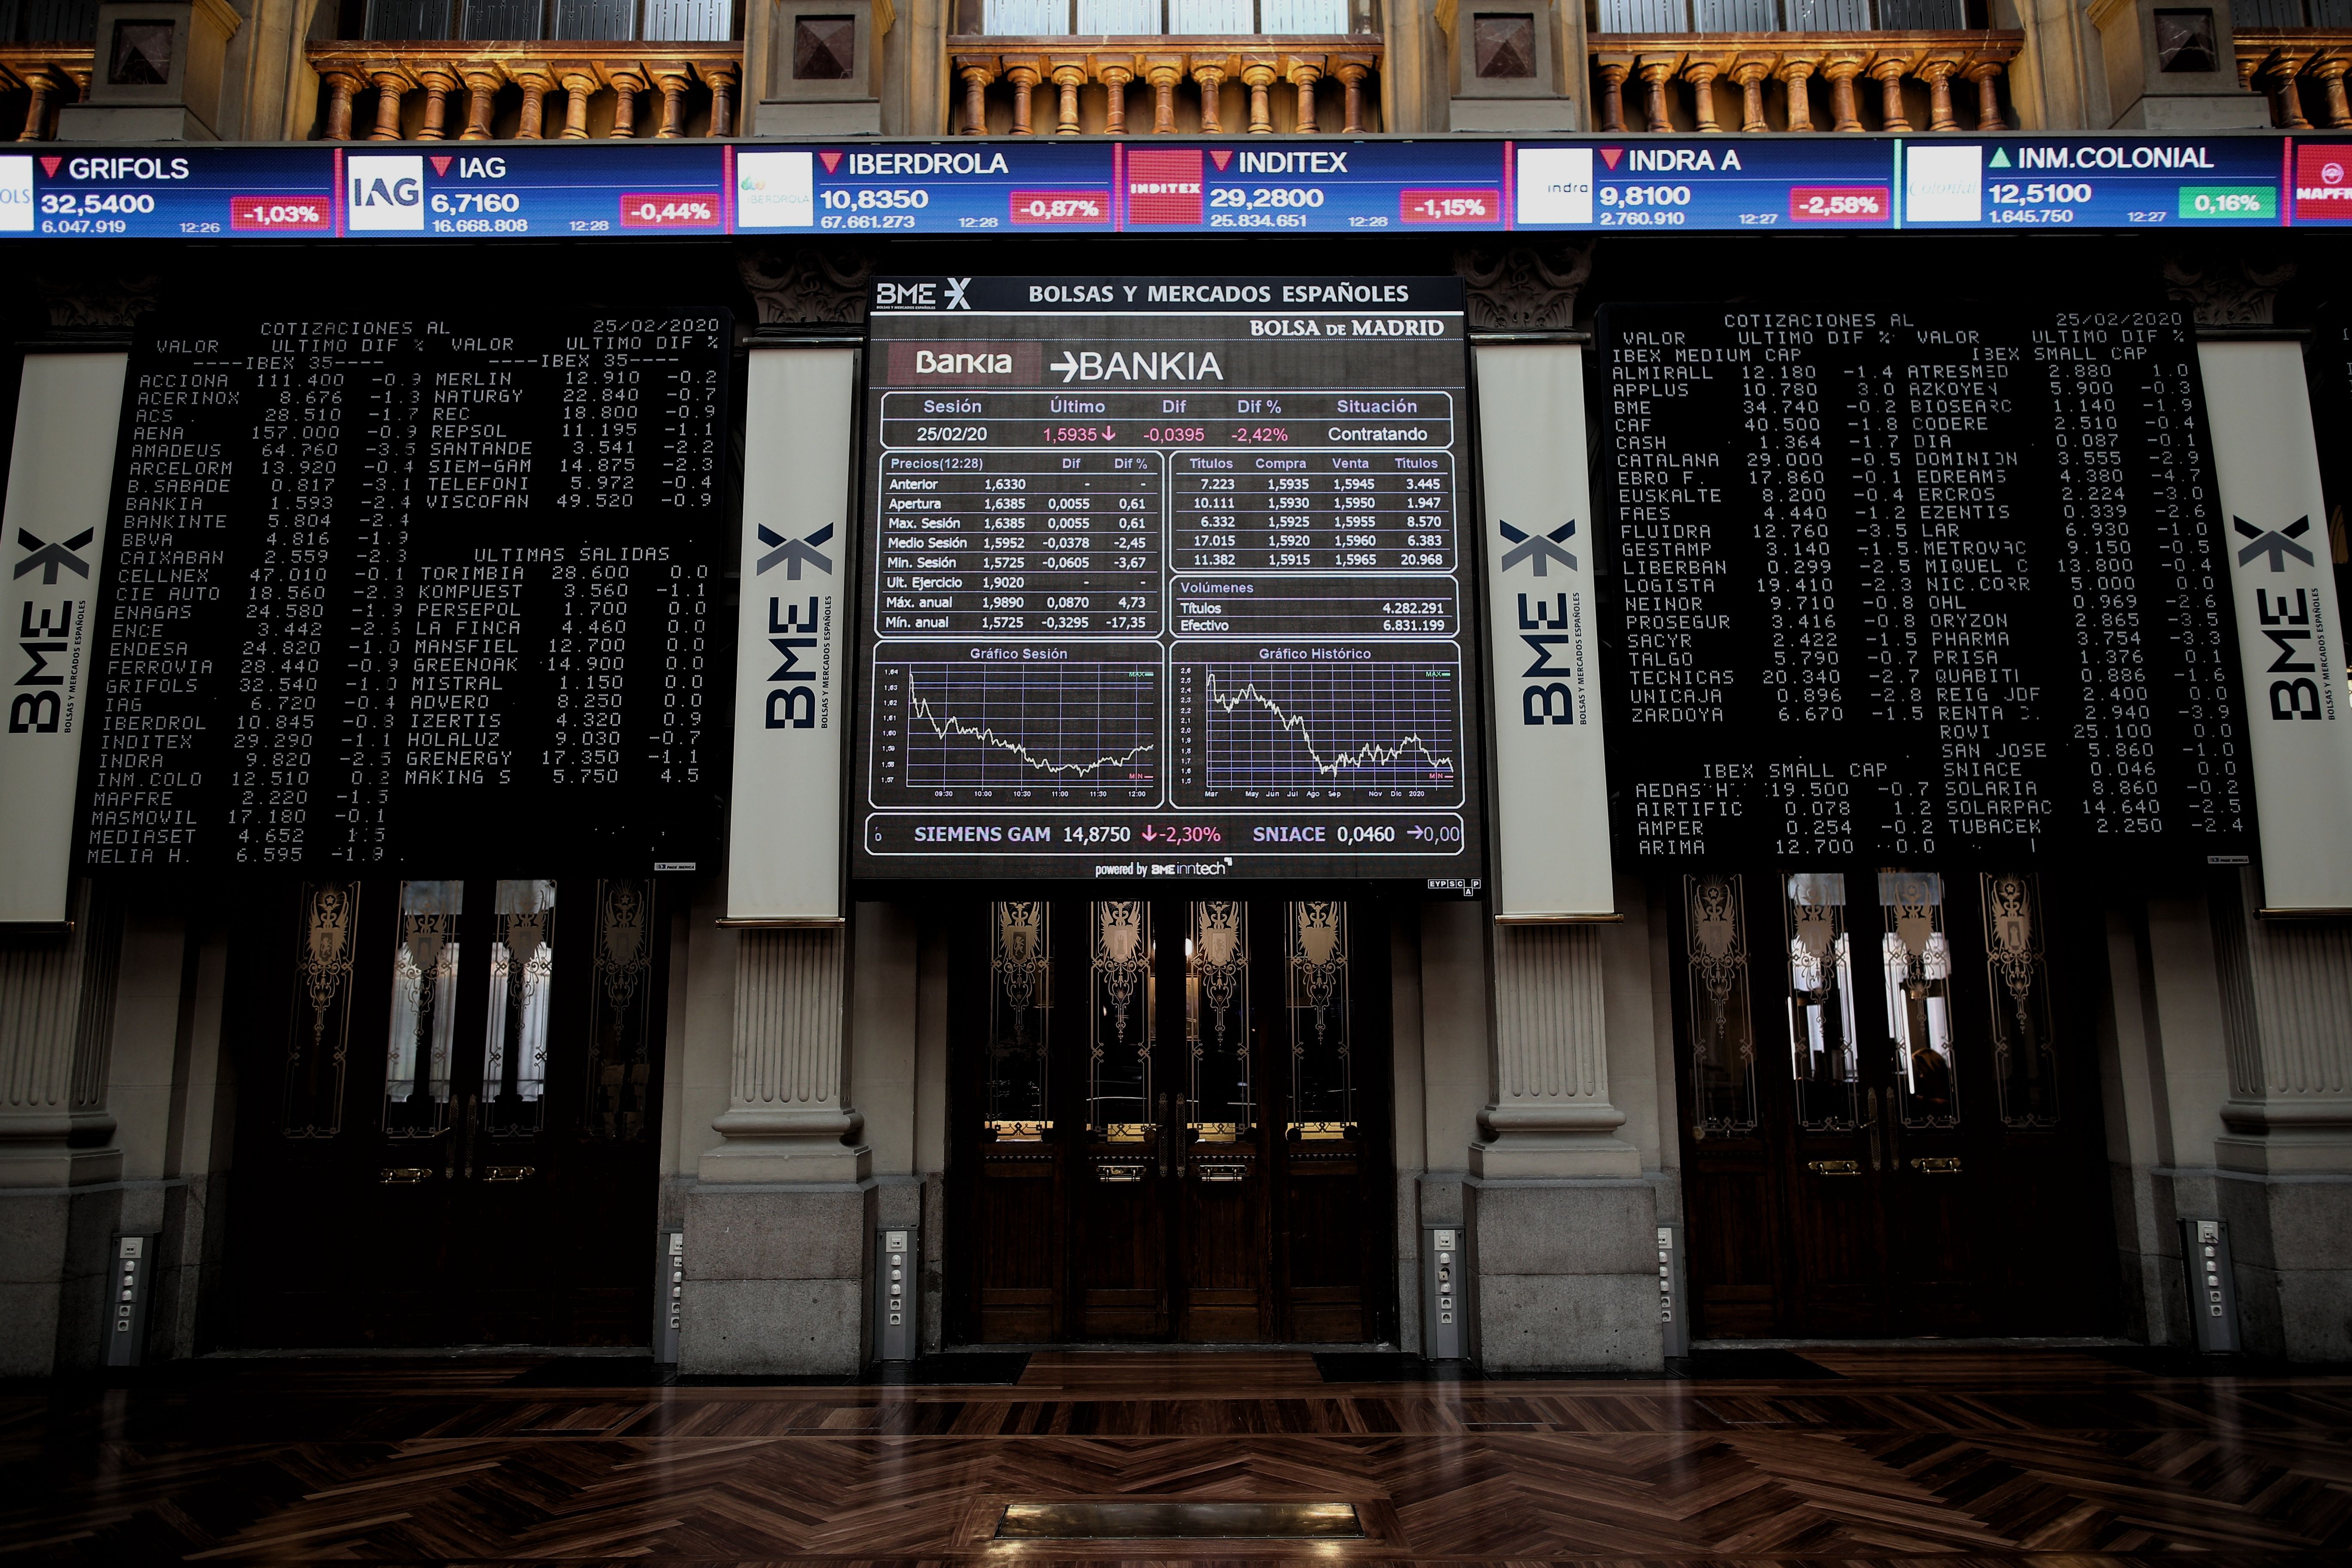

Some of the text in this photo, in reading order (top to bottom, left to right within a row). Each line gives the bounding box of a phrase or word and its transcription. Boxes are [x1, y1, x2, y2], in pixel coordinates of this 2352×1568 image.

[849, 153, 1009, 175] IBERDROLA
[1240, 152, 1348, 173] INDITEX
[1629, 149, 1742, 171] INDRA A
[2019, 147, 2214, 168] INM.COLONIAL
[69, 158, 189, 179] GRIFOLS
[460, 157, 506, 178] IAG
[354, 178, 419, 206] IAG
[1130, 183, 1200, 194] INDITEX
[1988, 184, 2092, 206] 12,5100
[431, 194, 519, 216] 6,7160
[820, 190, 928, 212] 10,8350
[1210, 189, 1324, 211] 29,2800
[1600, 186, 1690, 209] 9,8100
[2194, 195, 2260, 214] 0,16%
[41, 194, 155, 217] 32,5400
[631, 203, 710, 223] -0,44%
[1020, 200, 1099, 220] -0,87%
[1414, 199, 1485, 219] -1,15%
[1799, 196, 1879, 217] -2,58%
[244, 206, 319, 225] -1,03%
[821, 215, 916, 229] 67.661.273
[958, 217, 998, 227] 12:28
[1210, 214, 1306, 227] 25.834.651
[1348, 217, 1388, 227] 12:28
[1600, 212, 1685, 226] 2.760.910
[1739, 214, 1778, 224] 12:27
[1989, 209, 2073, 223] 1.645.750
[2127, 211, 2166, 222] 12:27
[42, 220, 126, 233] 6.047.919
[179, 223, 220, 233] 12:26
[432, 219, 528, 232] 16.668.808
[570, 220, 609, 231] 12:28
[877, 283, 936, 304] BME
[1029, 282, 1409, 303] BOLSAS Y MERCADOS ESPAÑOLES
[594, 318, 719, 333] 25/02/2020
[1724, 313, 1875, 328] COTIZACIONES
[2056, 312, 2182, 326] 25/02/2020
[261, 322, 412, 335] COTIZACIONES
[1250, 320, 1321, 336] BOLSA
[1351, 319, 1444, 336] MADRID
[157, 340, 218, 353] VALOR
[916, 350, 1012, 374] Bankia
[1613, 348, 1801, 362] IBEX MEDIUM CAP
[1080, 352, 1224, 380] BANKIA
[1613, 365, 1816, 380] ALMIRALL 12.180
[140, 374, 344, 388] ACCIONA 111.400
[924, 398, 981, 413] Sesión
[1050, 395, 1105, 413] Último
[1163, 400, 1187, 413] Dif
[1238, 400, 1281, 413] Dif %
[1337, 398, 1417, 413] Situación
[134, 426, 339, 440] AENA 157.000
[432, 423, 637, 438] REPSOL 11.195
[917, 427, 987, 441] 25/02/20
[1044, 428, 1097, 444] 1,5935
[1143, 428, 1204, 444] -0,0395
[1231, 428, 1288, 444] -2,42%
[1328, 427, 1427, 441] Contratando
[891, 458, 983, 472] Precios(12:28)
[1063, 458, 1081, 469] Dif
[1115, 458, 1148, 469] Dif %
[1189, 457, 1233, 469] Títulos
[1256, 458, 1307, 471] Compra
[1332, 458, 1369, 469] Venta
[1394, 457, 1438, 469] Títulos
[889, 478, 1026, 492] Anterior 1,6330
[1200, 478, 1440, 492] 7.223 1,5935 1,5945 3.445
[888, 498, 1145, 512] Apertura 1,6385 0,0055 0,61
[1621, 524, 1828, 539] FLUIDRA 12.760
[475, 547, 669, 562] ULTIMAS SALIDAS
[1194, 554, 1443, 567] 11.382 1,5915 1,5965 20.968
[1180, 581, 1254, 593] Volúmenes
[1624, 578, 1832, 593] LOGISTA 19.410
[1180, 602, 1444, 614] Títulos 4.282.291
[1573, 592, 1582, 637] ESPAÑOLES
[886, 616, 1145, 630] Mín. anual 1,5725 -0,3295 -17,35
[1181, 619, 1445, 631] Efectivo 6.831.199
[971, 647, 1067, 659] Gráfico Sesión
[1259, 647, 1371, 659] Gráfico Histórico
[1517, 593, 1573, 725] BME
[2256, 588, 2322, 720] BME
[8, 601, 73, 733] BME
[108, 659, 318, 674] FERROVIA 28.440
[765, 596, 818, 729] BME
[1576, 639, 1585, 684] MERCADOS
[412, 675, 623, 691] MISTRAL 1.150
[1632, 707, 1843, 722] ZARDOYA 6.670
[1704, 763, 1887, 778] IBEX SMALL CAP
[1945, 780, 2157, 796] SOLARIA 8.860
[1253, 826, 1395, 845] SNIACE 0,0460
[1424, 826, 1460, 845] 0,00
[1638, 820, 1852, 836] AMPER 0.254
[89, 828, 304, 844] MEDIASET 4.652
[914, 827, 1130, 846] SIEMENS GAM 14,8750
[1159, 827, 1221, 845] -2,30%
[1096, 862, 1133, 877] powered
[1137, 862, 1148, 877] by
